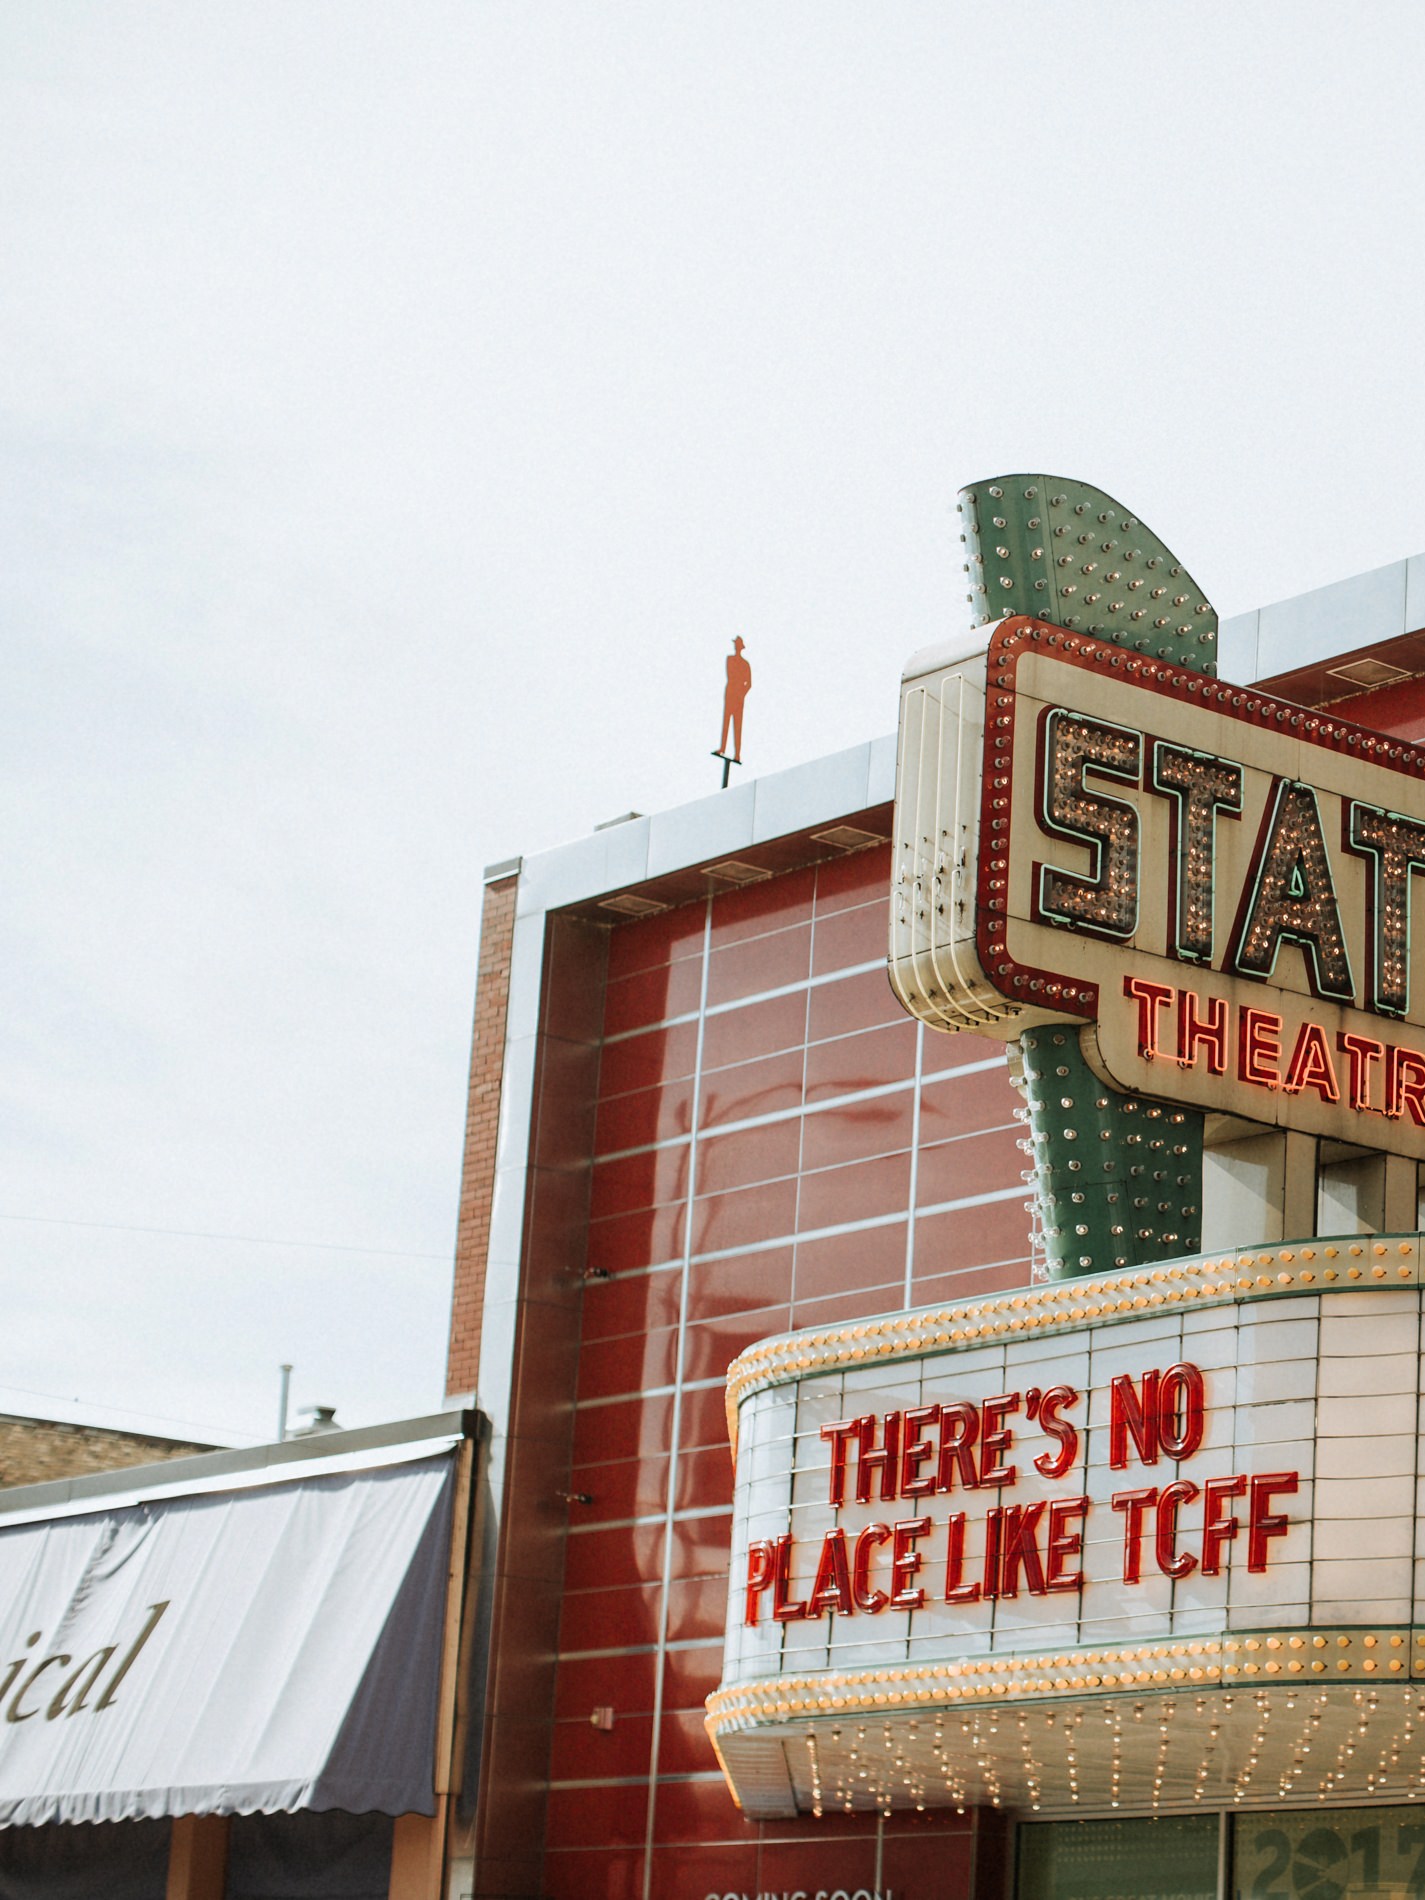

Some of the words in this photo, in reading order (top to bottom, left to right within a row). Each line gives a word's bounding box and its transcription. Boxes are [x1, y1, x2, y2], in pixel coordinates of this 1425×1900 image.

[820, 1384, 1078, 1509] THERE'S
[1110, 1361, 1204, 1471] NO
[745, 1515, 932, 1626] PLACE
[945, 1495, 1088, 1604] LIKE
[1112, 1471, 1299, 1585] TCFF
